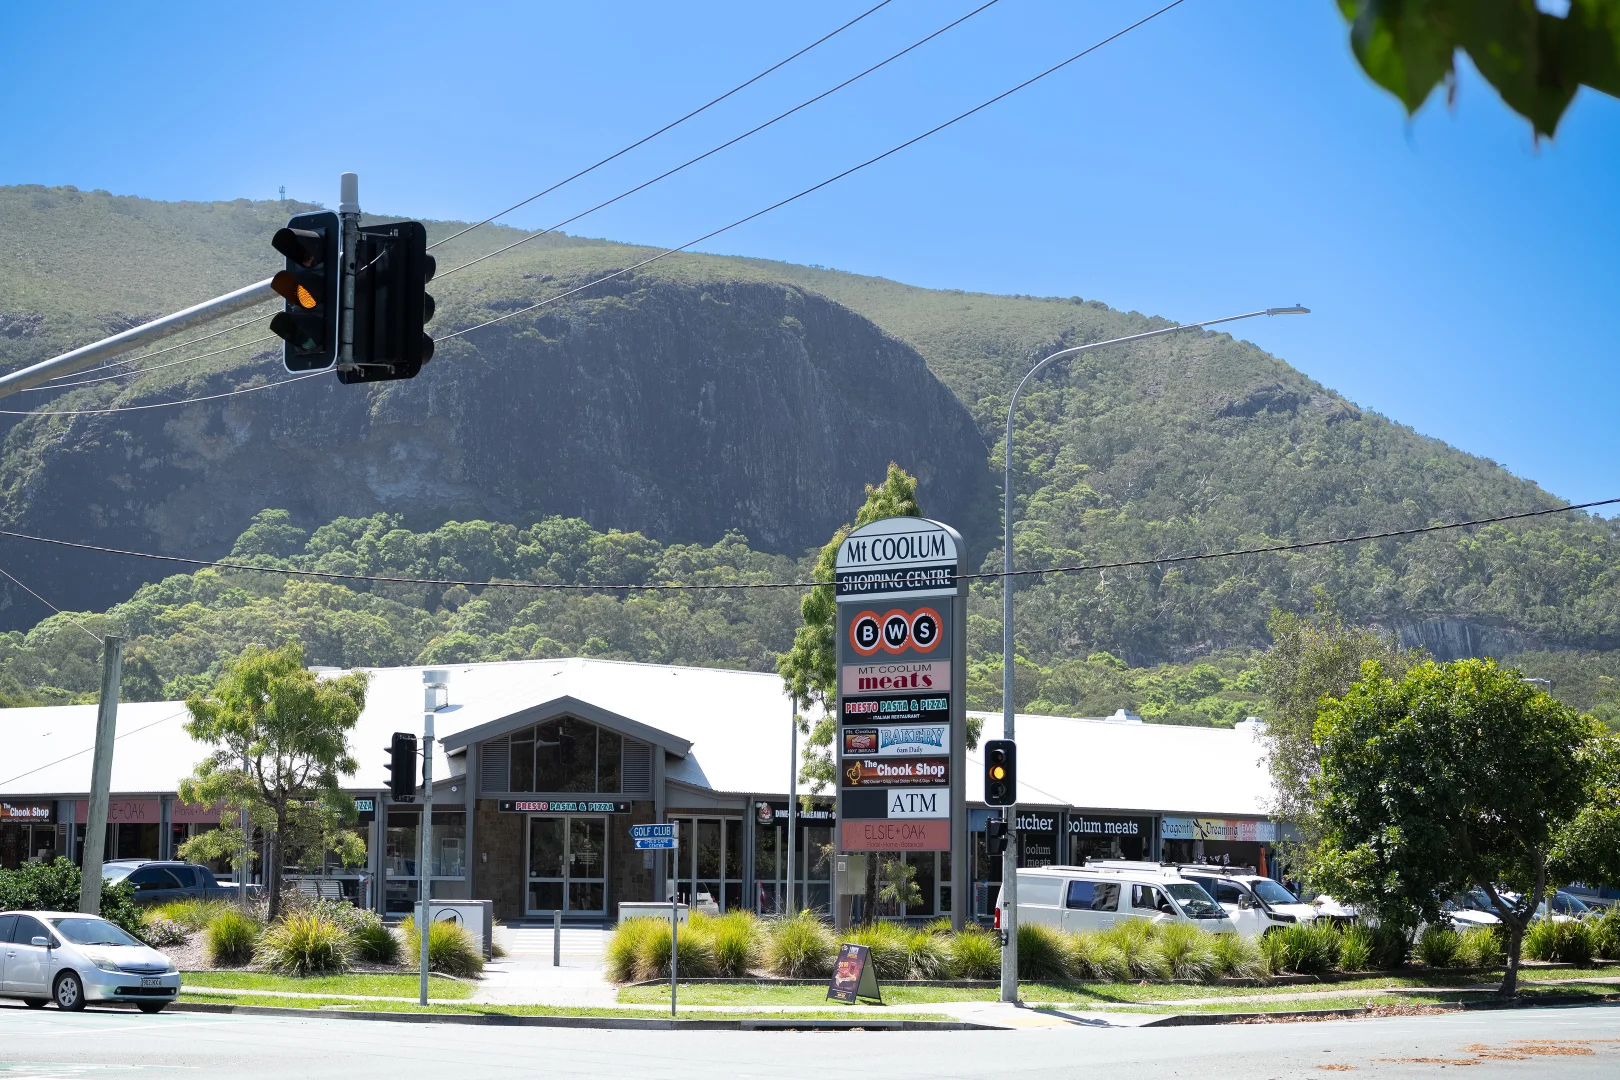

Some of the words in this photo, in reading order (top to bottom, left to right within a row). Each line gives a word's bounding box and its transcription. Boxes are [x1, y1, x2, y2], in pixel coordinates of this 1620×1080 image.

[847, 541, 867, 563] Mt
[871, 534, 946, 561] COOLUM
[842, 572, 903, 592] SHOPPING
[906, 569, 951, 588] CENTRE
[858, 666, 876, 675] MT
[878, 663, 932, 674] COOLUM
[858, 671, 933, 690] meats
[845, 701, 879, 714] PRESTO
[880, 700, 909, 713] PASTA
[910, 699, 919, 712] &
[920, 698, 948, 711] PIZZA
[880, 727, 945, 749] BAKERY
[908, 746, 923, 755] Daily
[864, 760, 878, 768] The
[877, 763, 913, 776] Chook
[915, 762, 945, 778] Shop
[354, 799, 374, 812] IZZA
[515, 801, 548, 811] PRESTO
[549, 802, 577, 811] PASTA
[578, 802, 587, 811] &
[588, 802, 614, 811] PIZZA
[890, 793, 937, 813] ATM
[9, 807, 31, 817] Chook
[32, 807, 50, 819] Shop
[1015, 814, 1054, 831] utcher
[1068, 817, 1102, 833] oolum
[1104, 820, 1139, 835] meats
[1206, 821, 1239, 838] Dreaming
[633, 826, 651, 837] GOLF
[653, 826, 671, 836] CLUB
[864, 824, 895, 840] ELSIE
[901, 823, 926, 840] OAK
